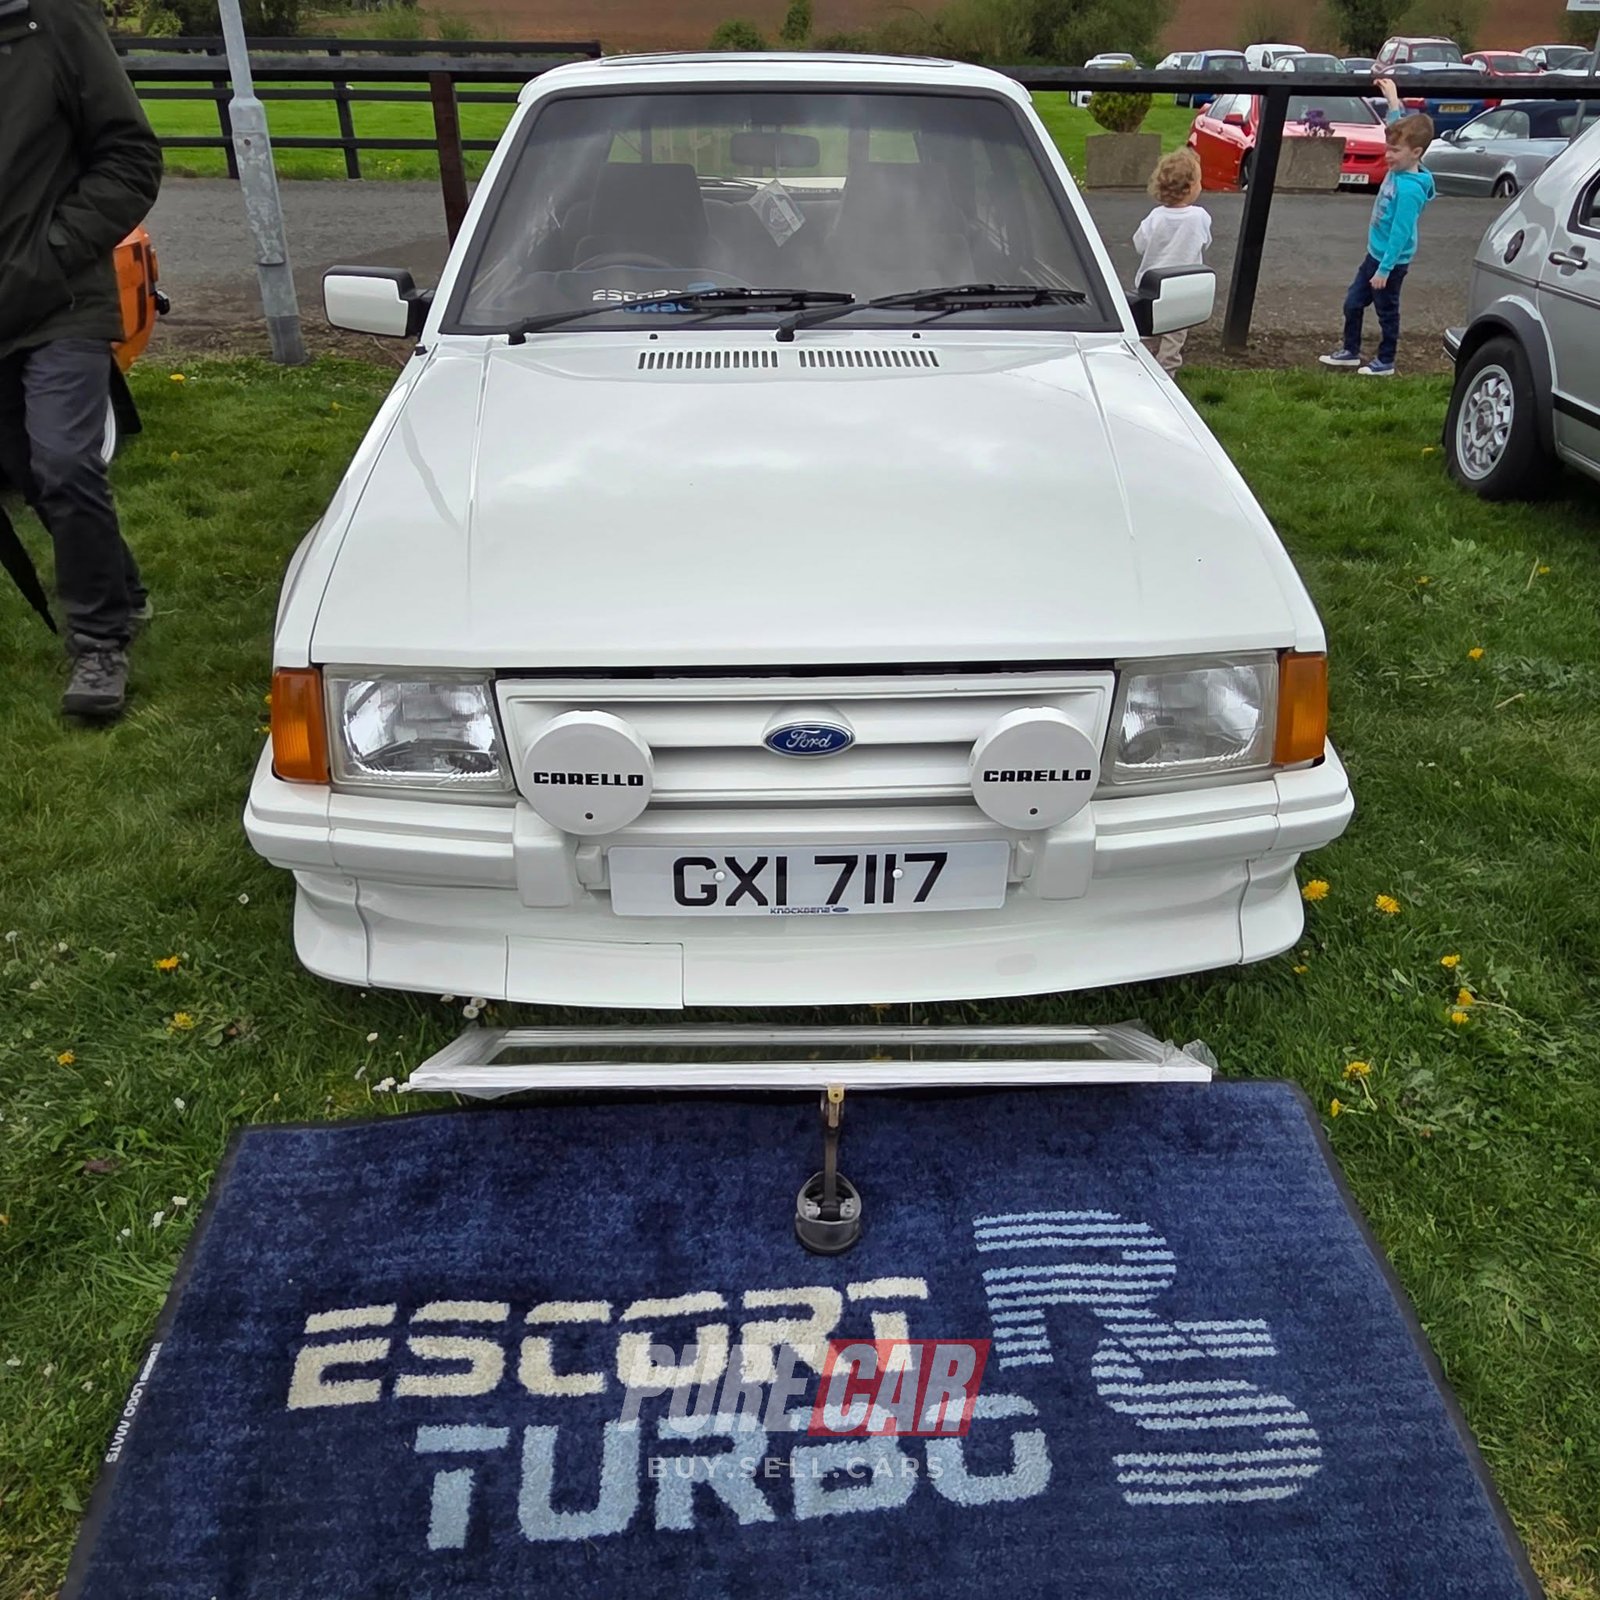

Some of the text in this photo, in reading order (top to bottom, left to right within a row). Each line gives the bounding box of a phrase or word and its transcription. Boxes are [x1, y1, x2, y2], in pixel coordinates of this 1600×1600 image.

[786, 729, 832, 748] Ford
[533, 771, 644, 787] CARELLO
[983, 769, 1092, 783] CARELLO
[673, 852, 948, 907] GXI 7117
[287, 1277, 929, 1410] ESCORT
[972, 1208, 1323, 1505] RS
[105, 1382, 146, 1463] LOGO MATS
[414, 1394, 1052, 1550] TURBO
